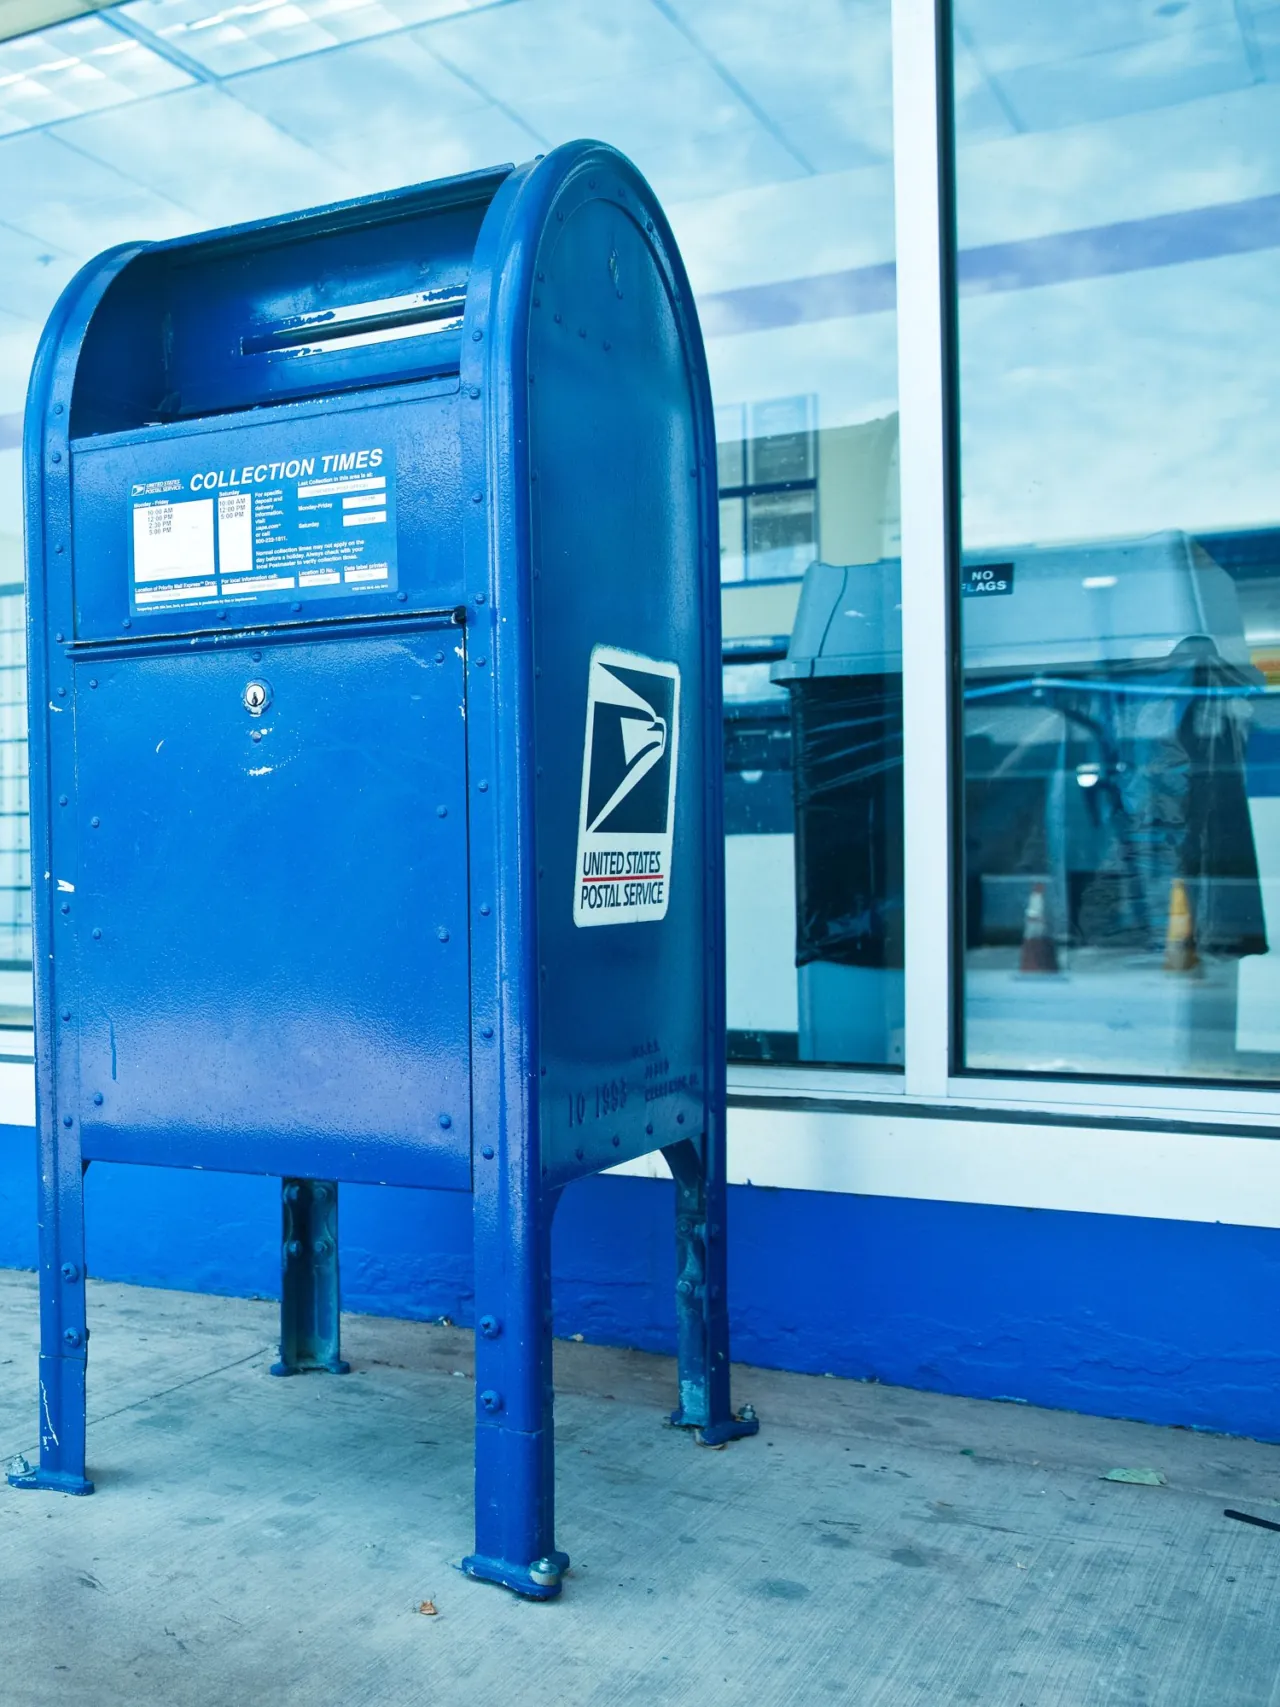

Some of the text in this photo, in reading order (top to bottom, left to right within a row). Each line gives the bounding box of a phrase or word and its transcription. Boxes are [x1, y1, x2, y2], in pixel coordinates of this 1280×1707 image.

[189, 448, 383, 491] COLLECTION TIMES
[309, 477, 333, 486] Collection
[146, 487, 163, 495] POSTAL
[264, 489, 283, 497] specific
[134, 501, 151, 509] Monday
[255, 497, 273, 505] deposit
[299, 502, 333, 511] Monday-Friday
[148, 508, 162, 516] 10:00
[148, 515, 162, 523] 12:00
[268, 560, 297, 568] Postmaster
[317, 555, 342, 563] collection
[299, 568, 319, 576] Location
[971, 570, 994, 581] NO
[583, 851, 662, 876] UNITED STATES
[580, 882, 664, 909] POSTAL SERVICE
[569, 1091, 586, 1128] 10
